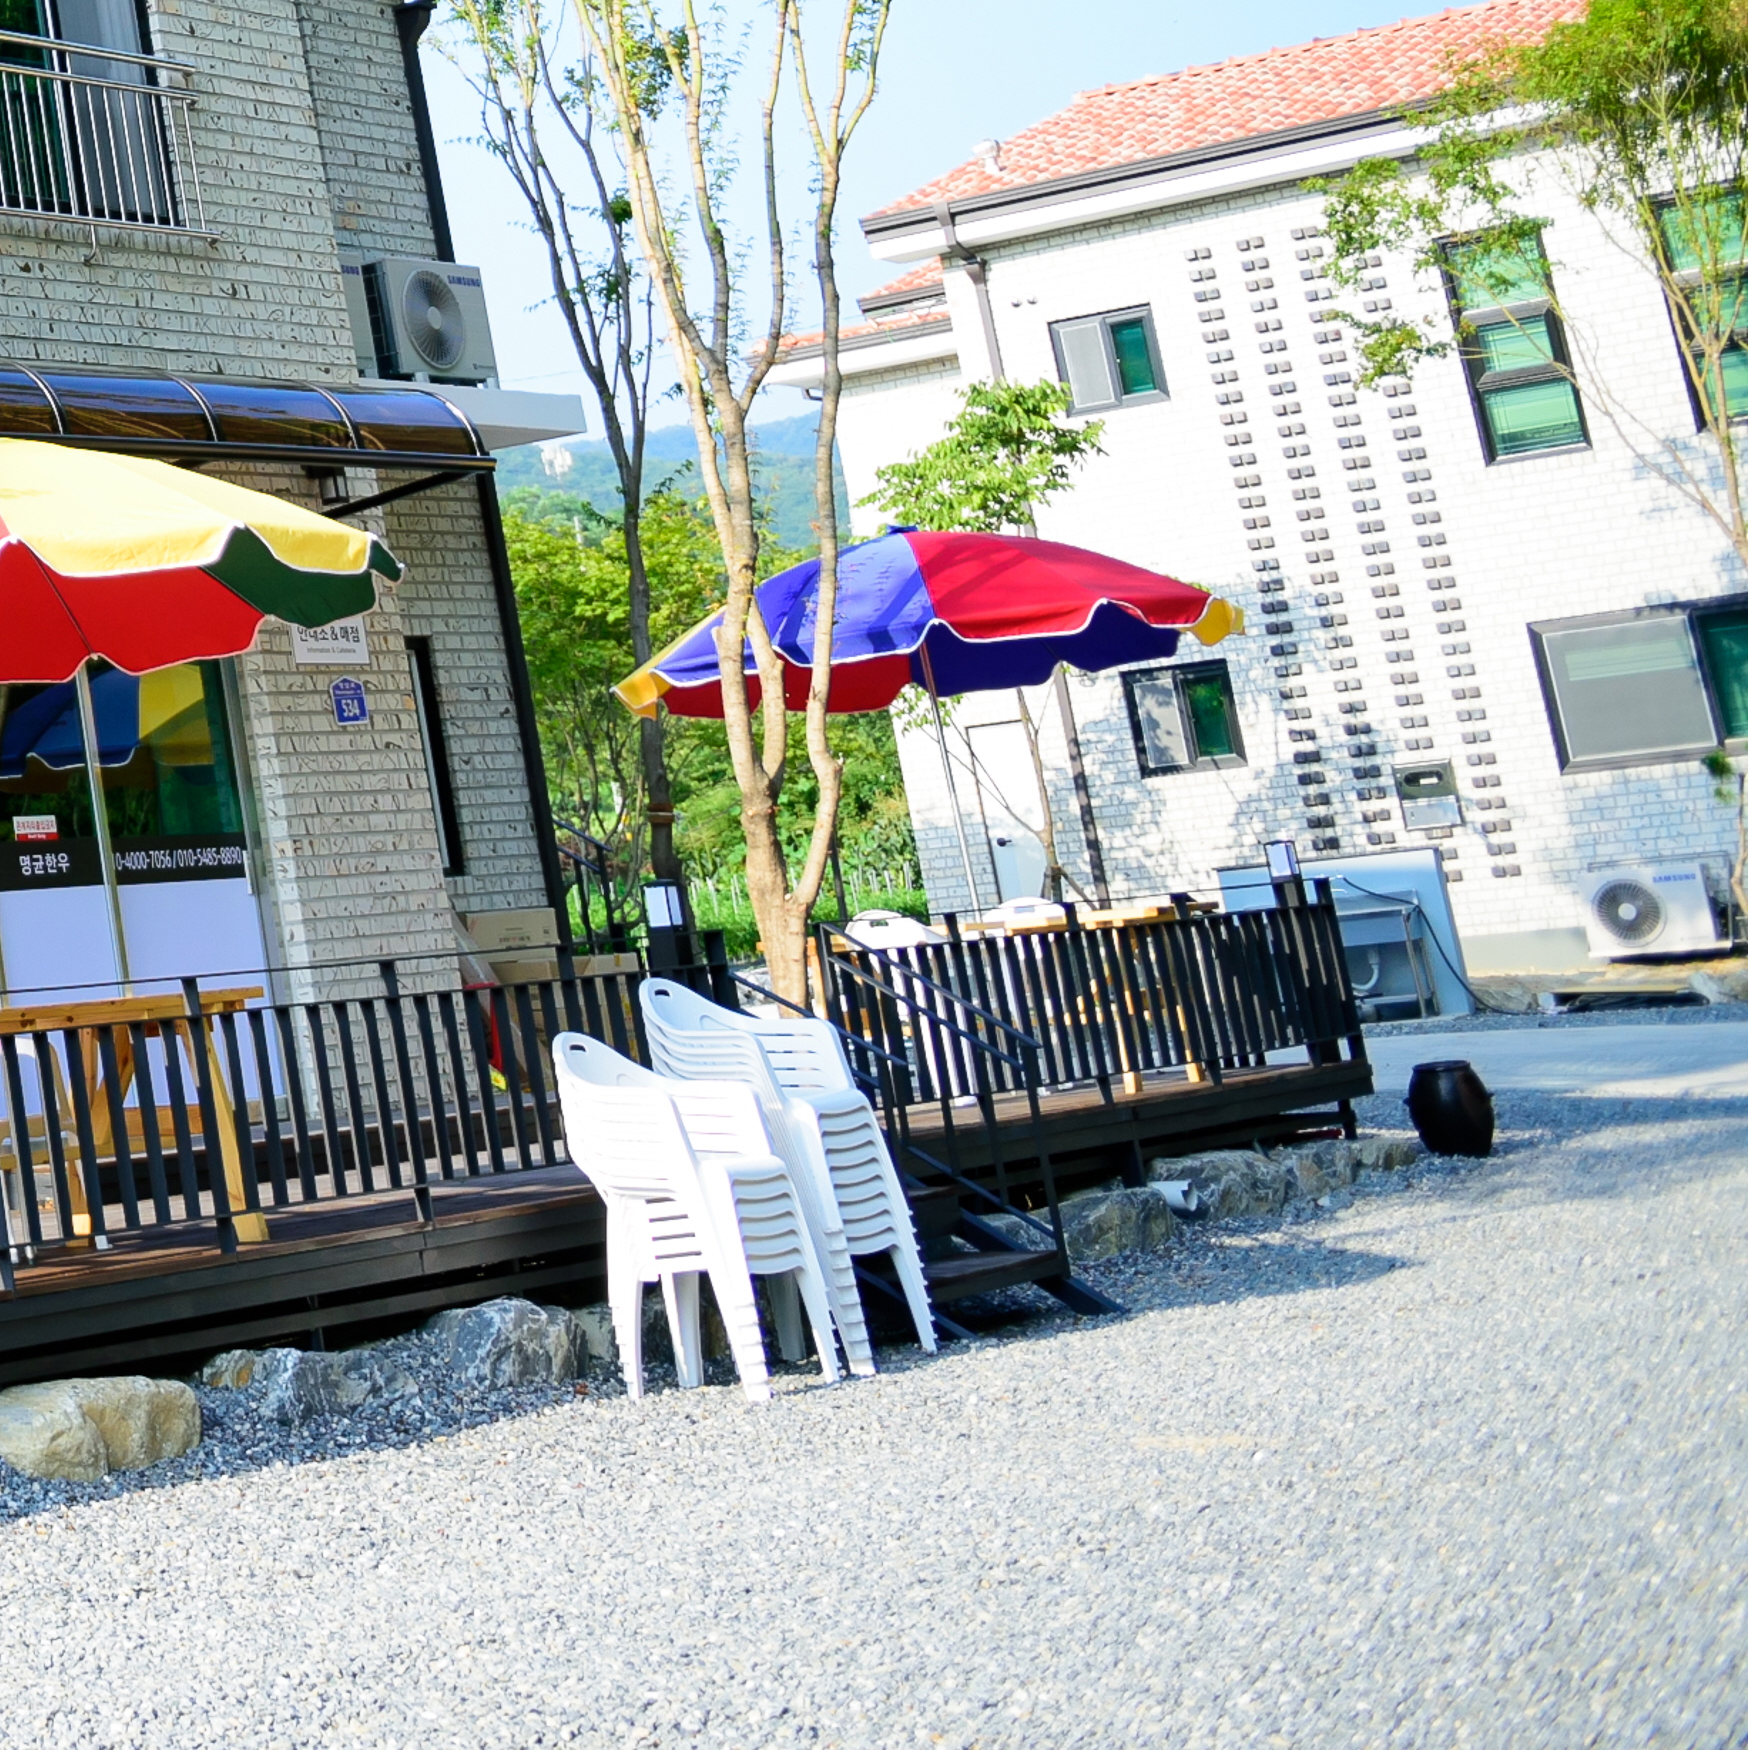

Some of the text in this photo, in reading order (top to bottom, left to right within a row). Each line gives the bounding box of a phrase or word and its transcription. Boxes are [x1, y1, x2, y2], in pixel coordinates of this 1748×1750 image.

[447, 274, 481, 287] SAMSUNG
[341, 699, 361, 717] 534
[18, 852, 71, 877] 명균한우
[1652, 873, 1696, 884] SAMSUNG
